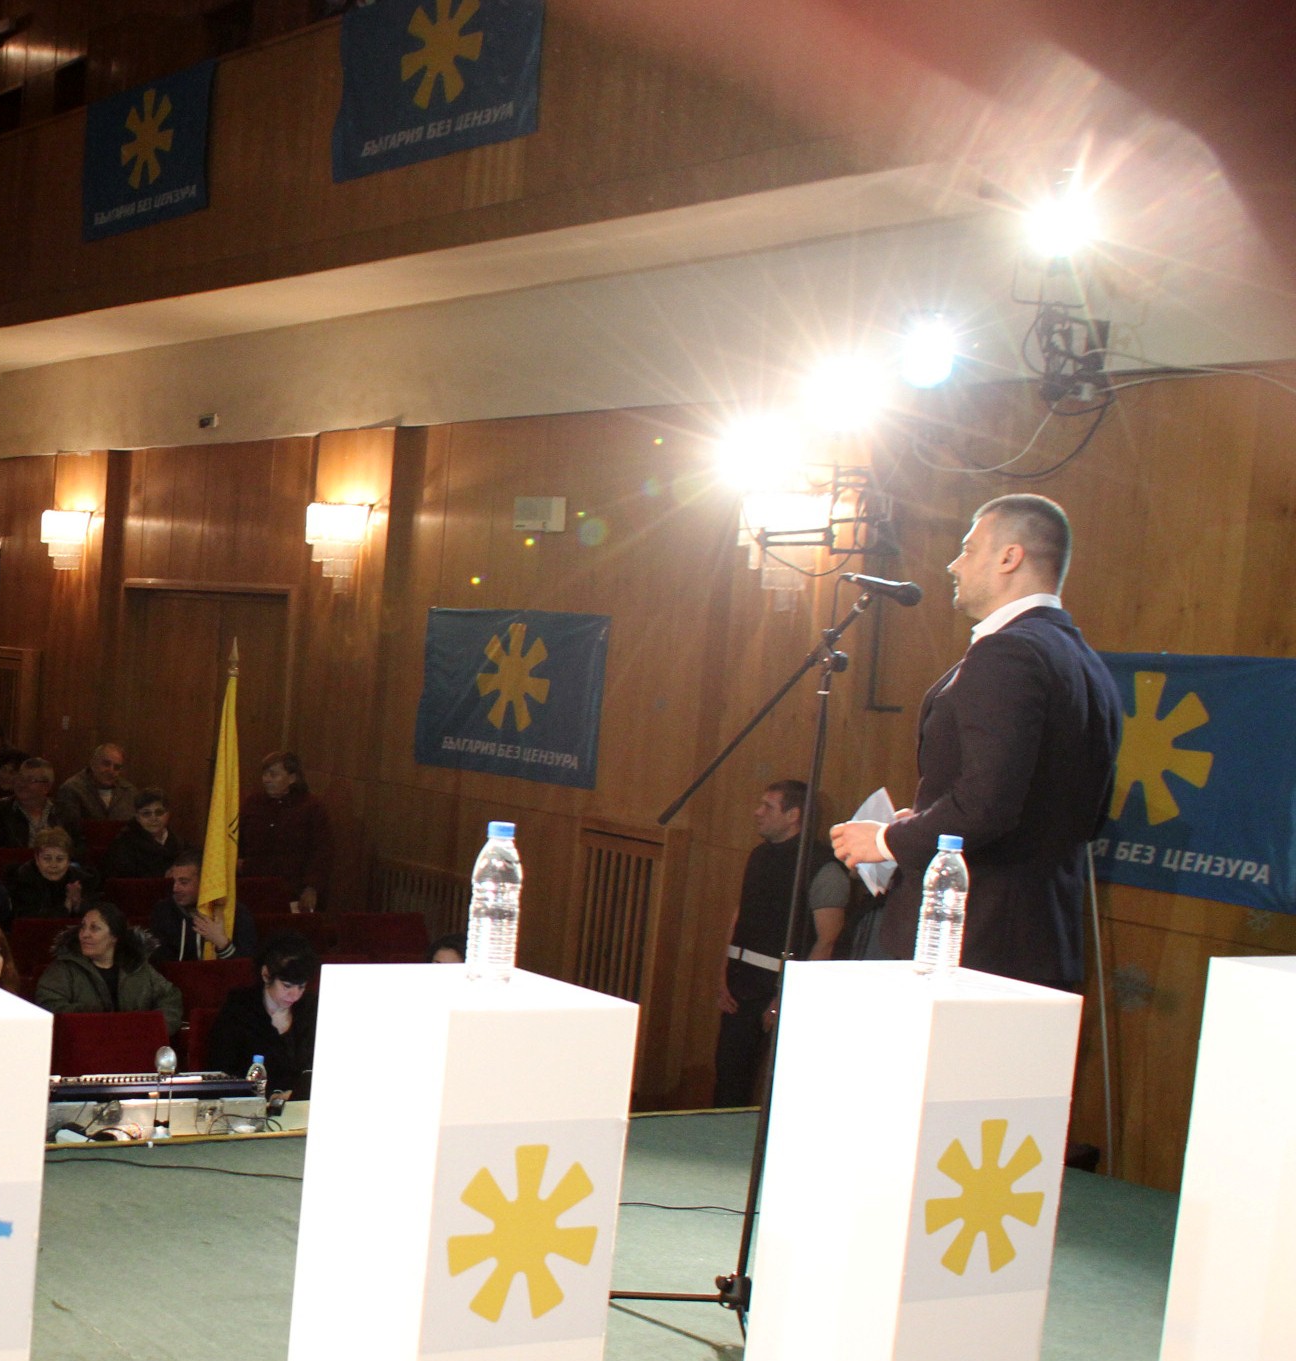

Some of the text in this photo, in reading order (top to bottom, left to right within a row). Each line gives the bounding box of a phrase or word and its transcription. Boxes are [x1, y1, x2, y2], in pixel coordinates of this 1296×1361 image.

[426, 119, 452, 140] БЕЗ
[455, 102, 515, 132] ЦЕНЗУРА
[441, 735, 580, 770] БЪЛГАРИЯ БЕЗ ЦЕНЗУРА
[1114, 841, 1156, 865] БЕЗ
[1161, 848, 1271, 884] ЦЕНЗУРА
